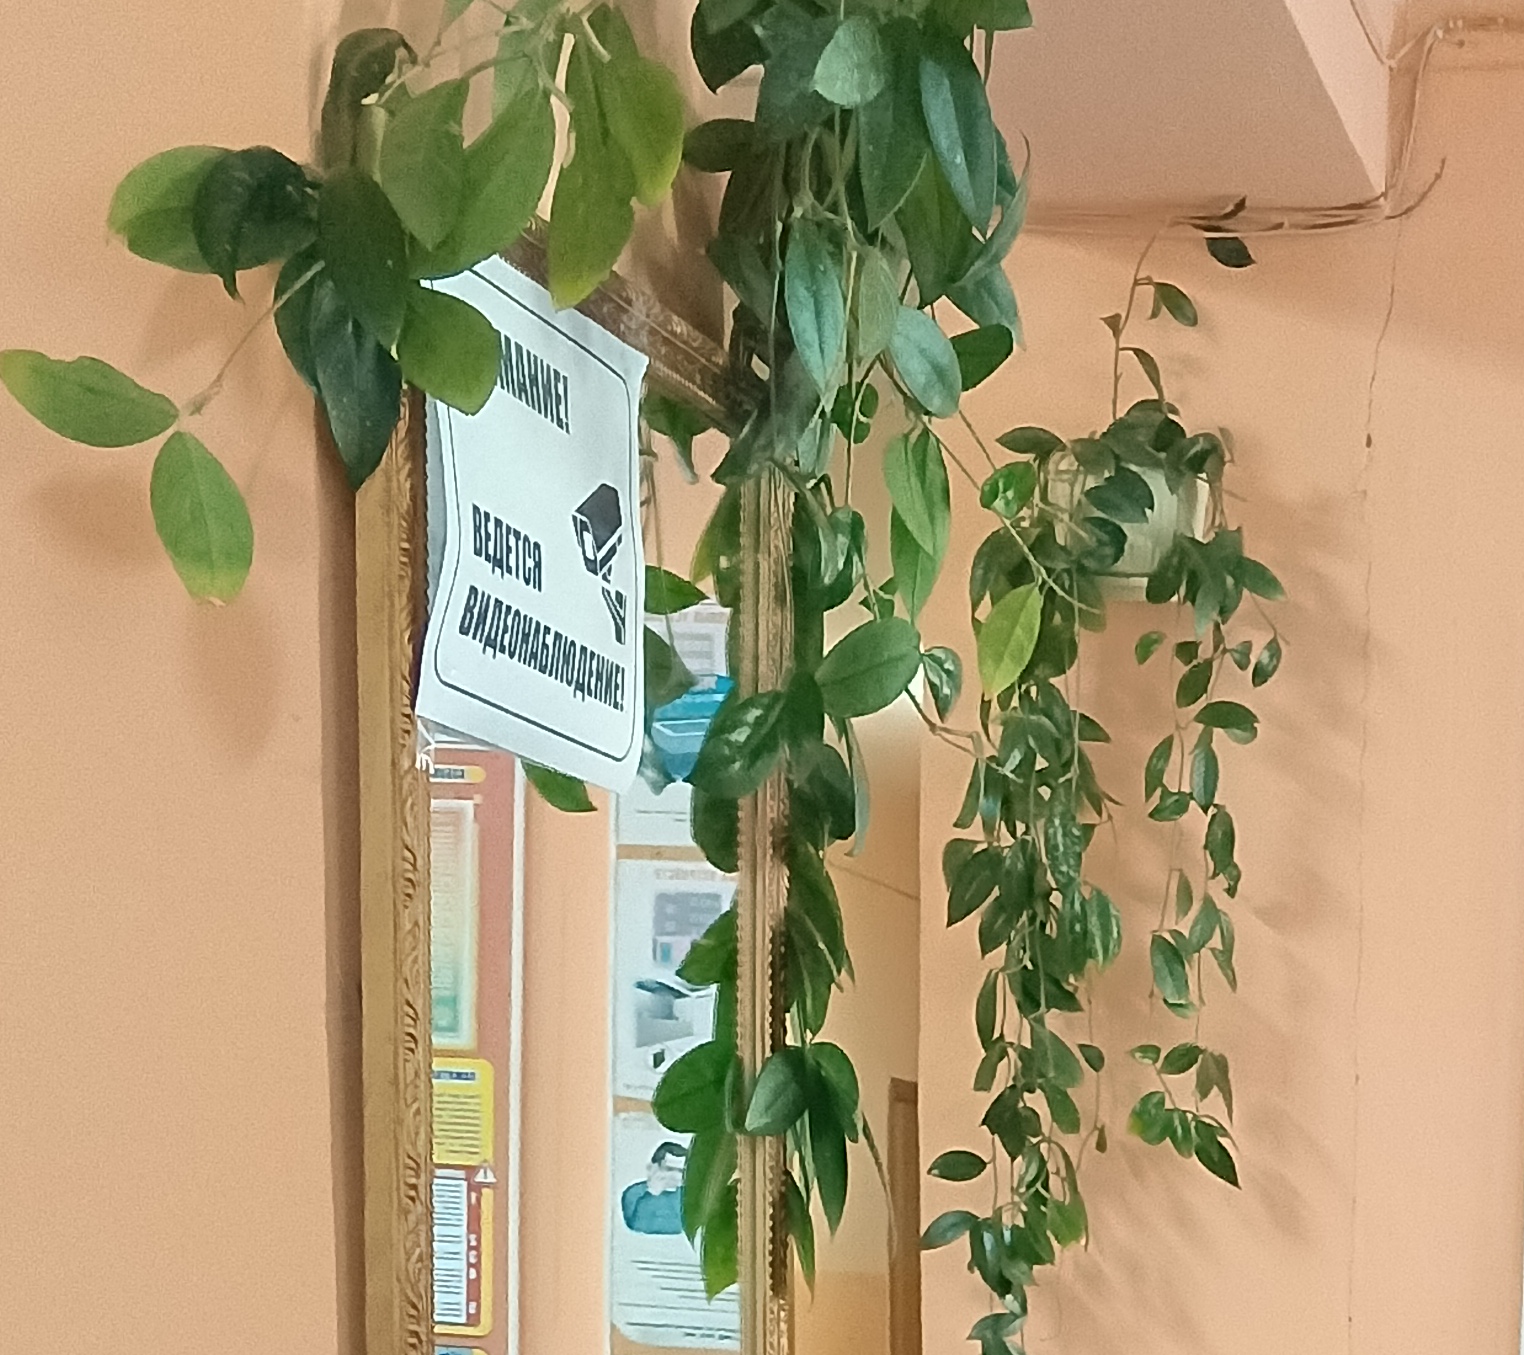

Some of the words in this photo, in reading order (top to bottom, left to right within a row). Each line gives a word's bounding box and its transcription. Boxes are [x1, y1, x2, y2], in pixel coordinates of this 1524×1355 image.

[499, 333, 571, 436] МАНИЕ!
[472, 502, 543, 593] ВЕДЕТСЯ
[458, 584, 626, 713] ВИДЕОНАБЛЮДЕНИЕ!
